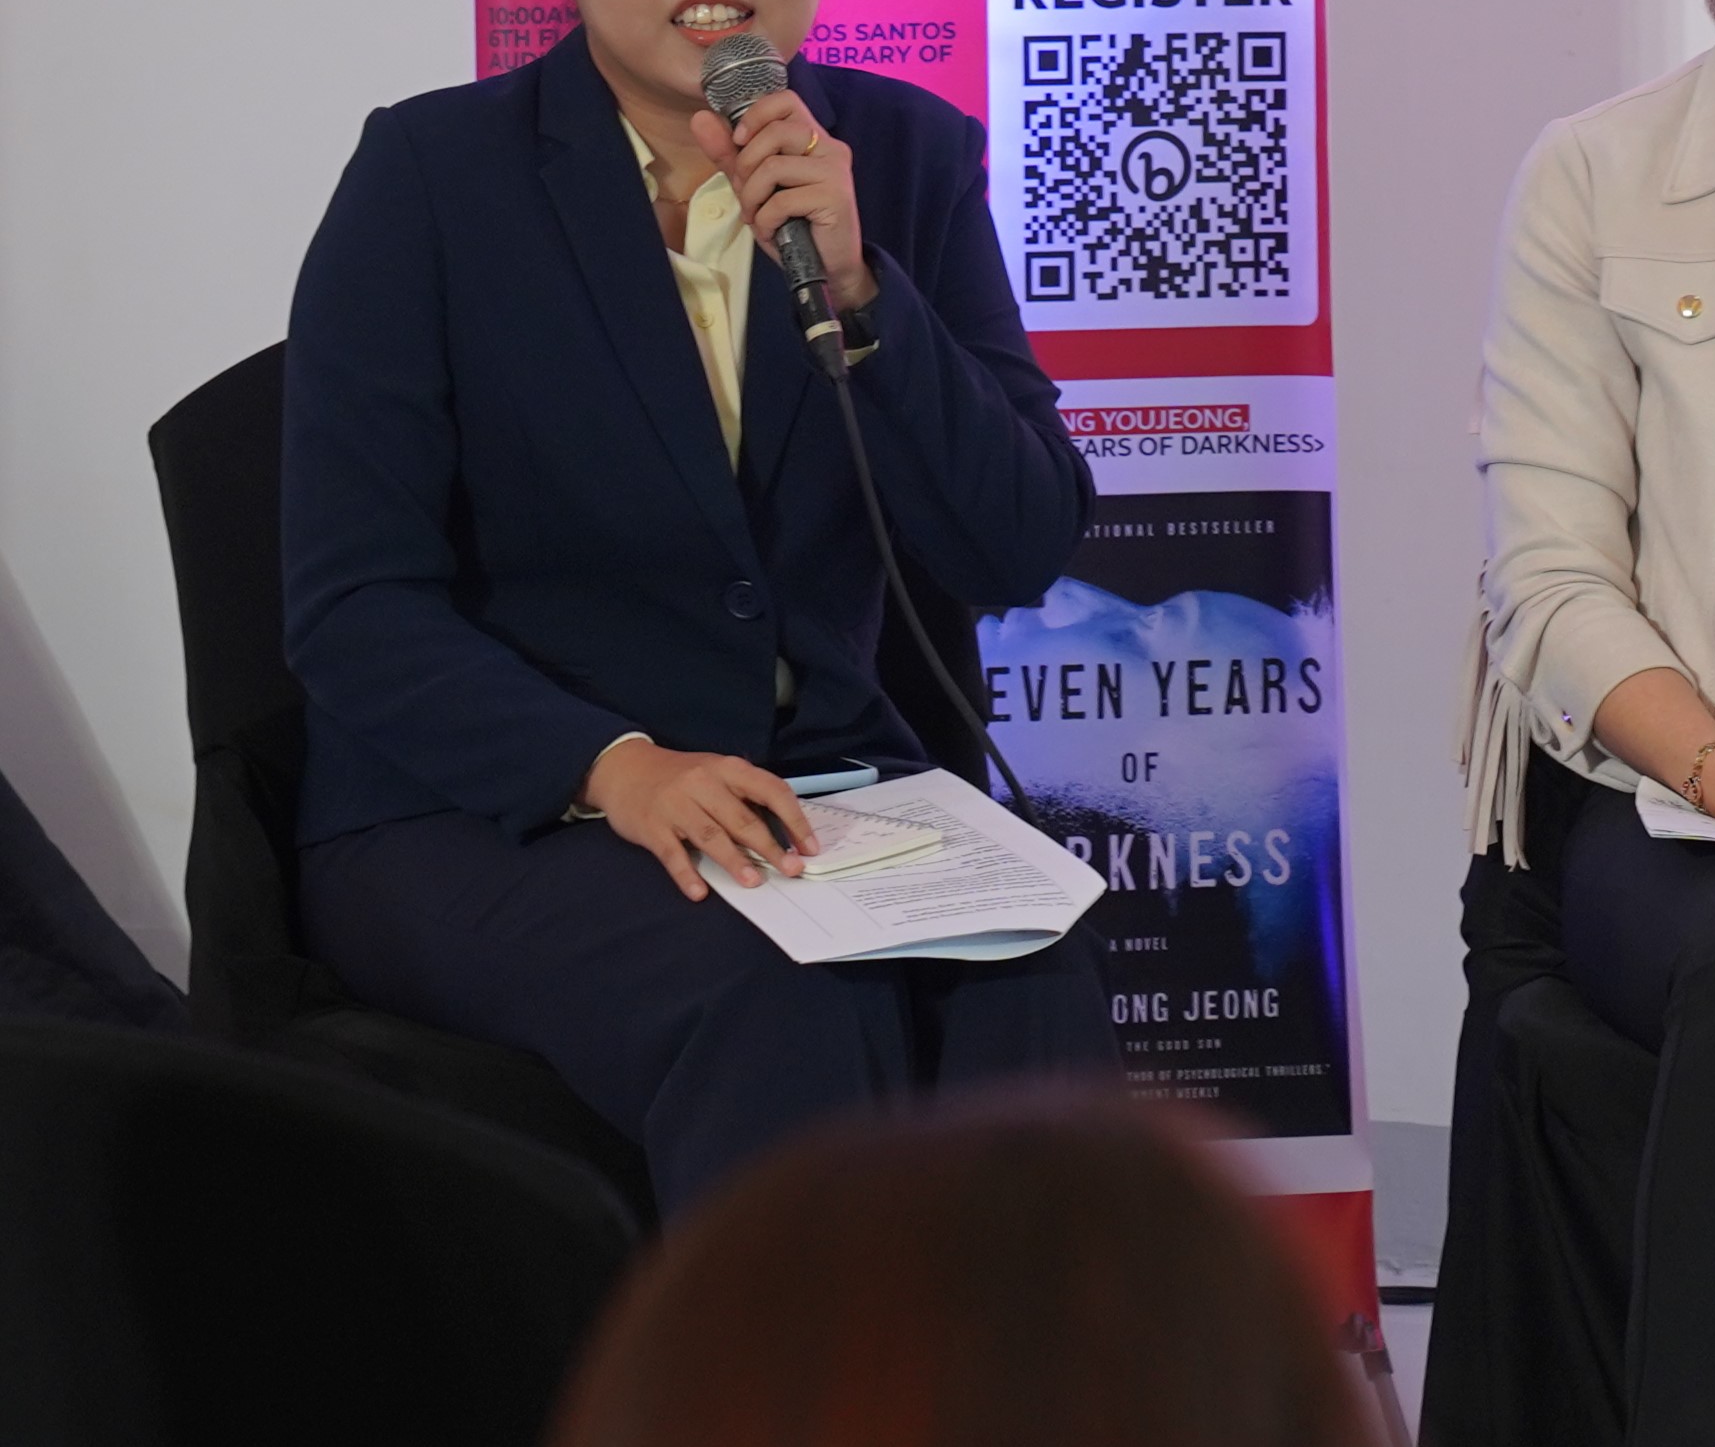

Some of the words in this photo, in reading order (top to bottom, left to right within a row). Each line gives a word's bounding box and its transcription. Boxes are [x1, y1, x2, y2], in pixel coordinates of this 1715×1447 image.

[805, 24, 847, 42] OS
[855, 22, 956, 41] SANTOS
[803, 46, 911, 64] LIBRARY
[919, 44, 953, 63] OF
[1100, 408, 1249, 431] YOUJEONG,
[1070, 437, 1132, 458] ARS
[1139, 436, 1174, 456] OF
[1084, 524, 1155, 539] TIONAL
[1167, 520, 1276, 536] BESTSELLER
[1152, 657, 1323, 717] YEARS
[1121, 752, 1159, 783] OF
[1066, 829, 1291, 892] KNESS
[1125, 937, 1168, 951] NOVEL
[1183, 988, 1279, 1021] JEONG
